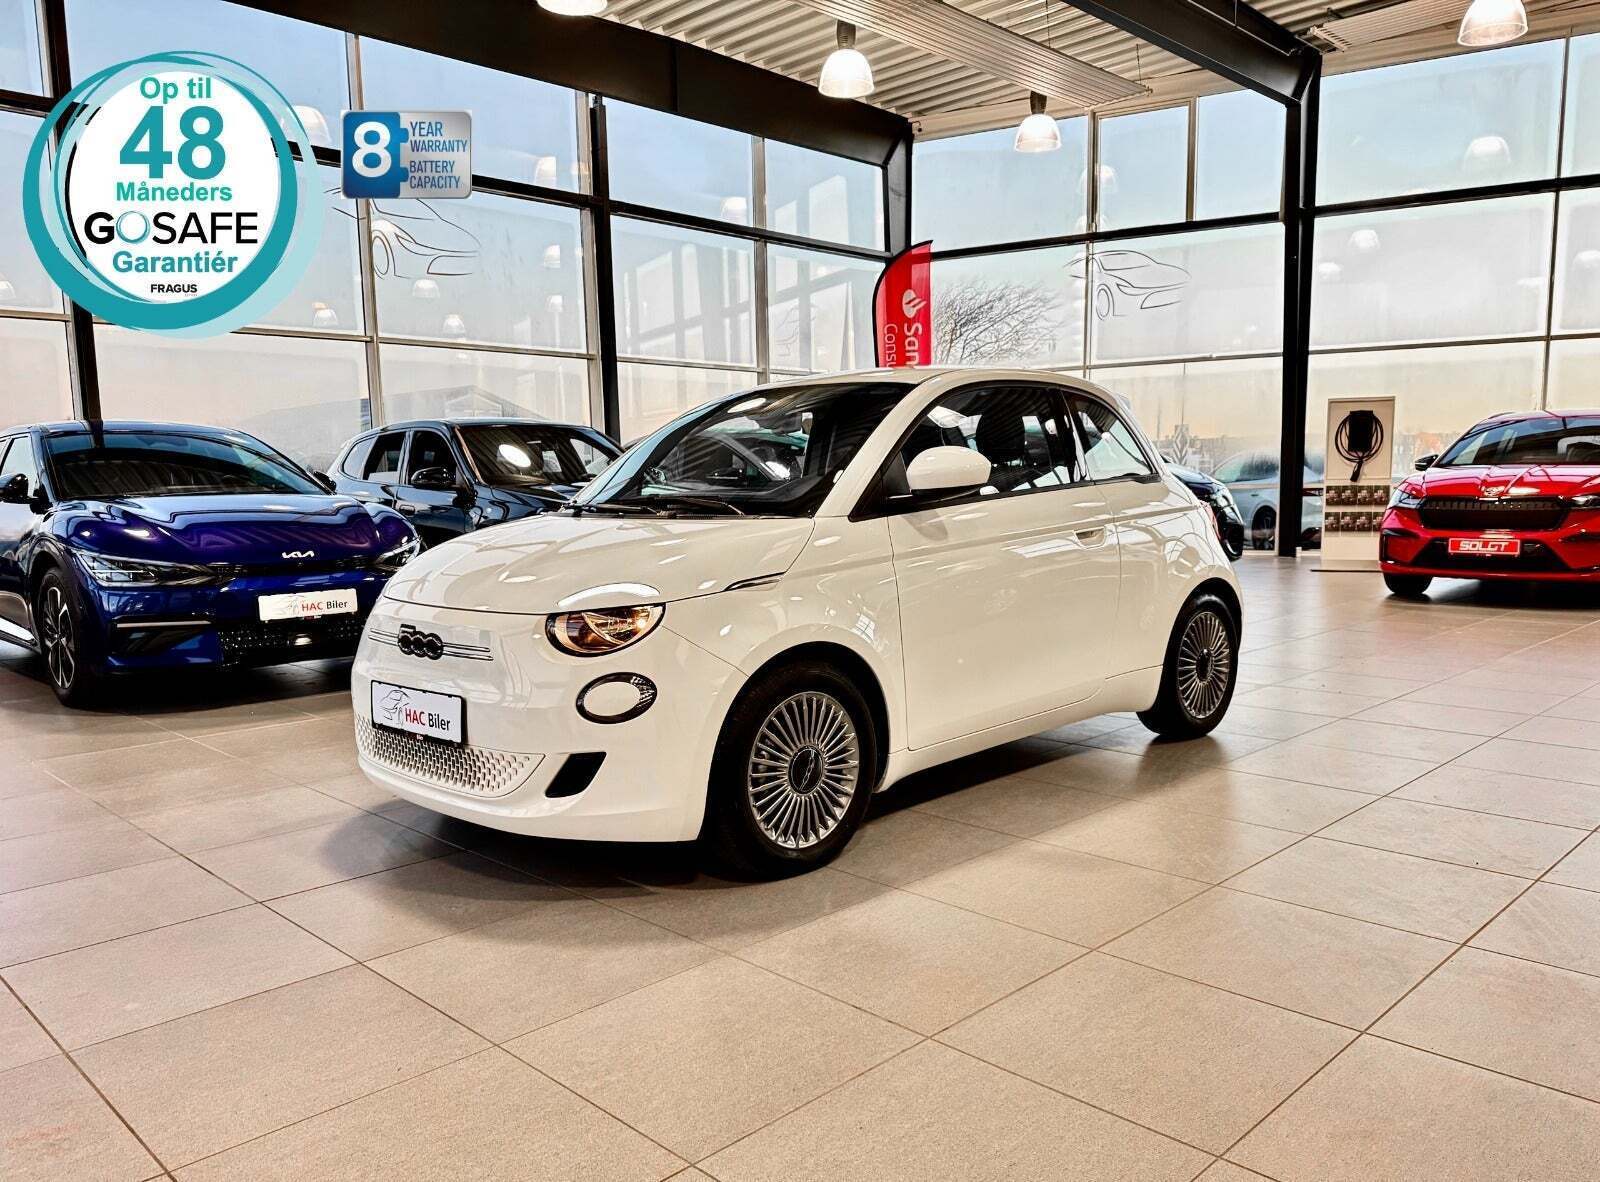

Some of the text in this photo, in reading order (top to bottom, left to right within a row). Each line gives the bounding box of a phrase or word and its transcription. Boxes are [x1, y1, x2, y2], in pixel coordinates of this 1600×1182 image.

[1459, 540, 1509, 552] SOLGT
[301, 600, 348, 612] HAC Biler
[398, 623, 444, 660] 500
[404, 707, 451, 731] HAC Biler
